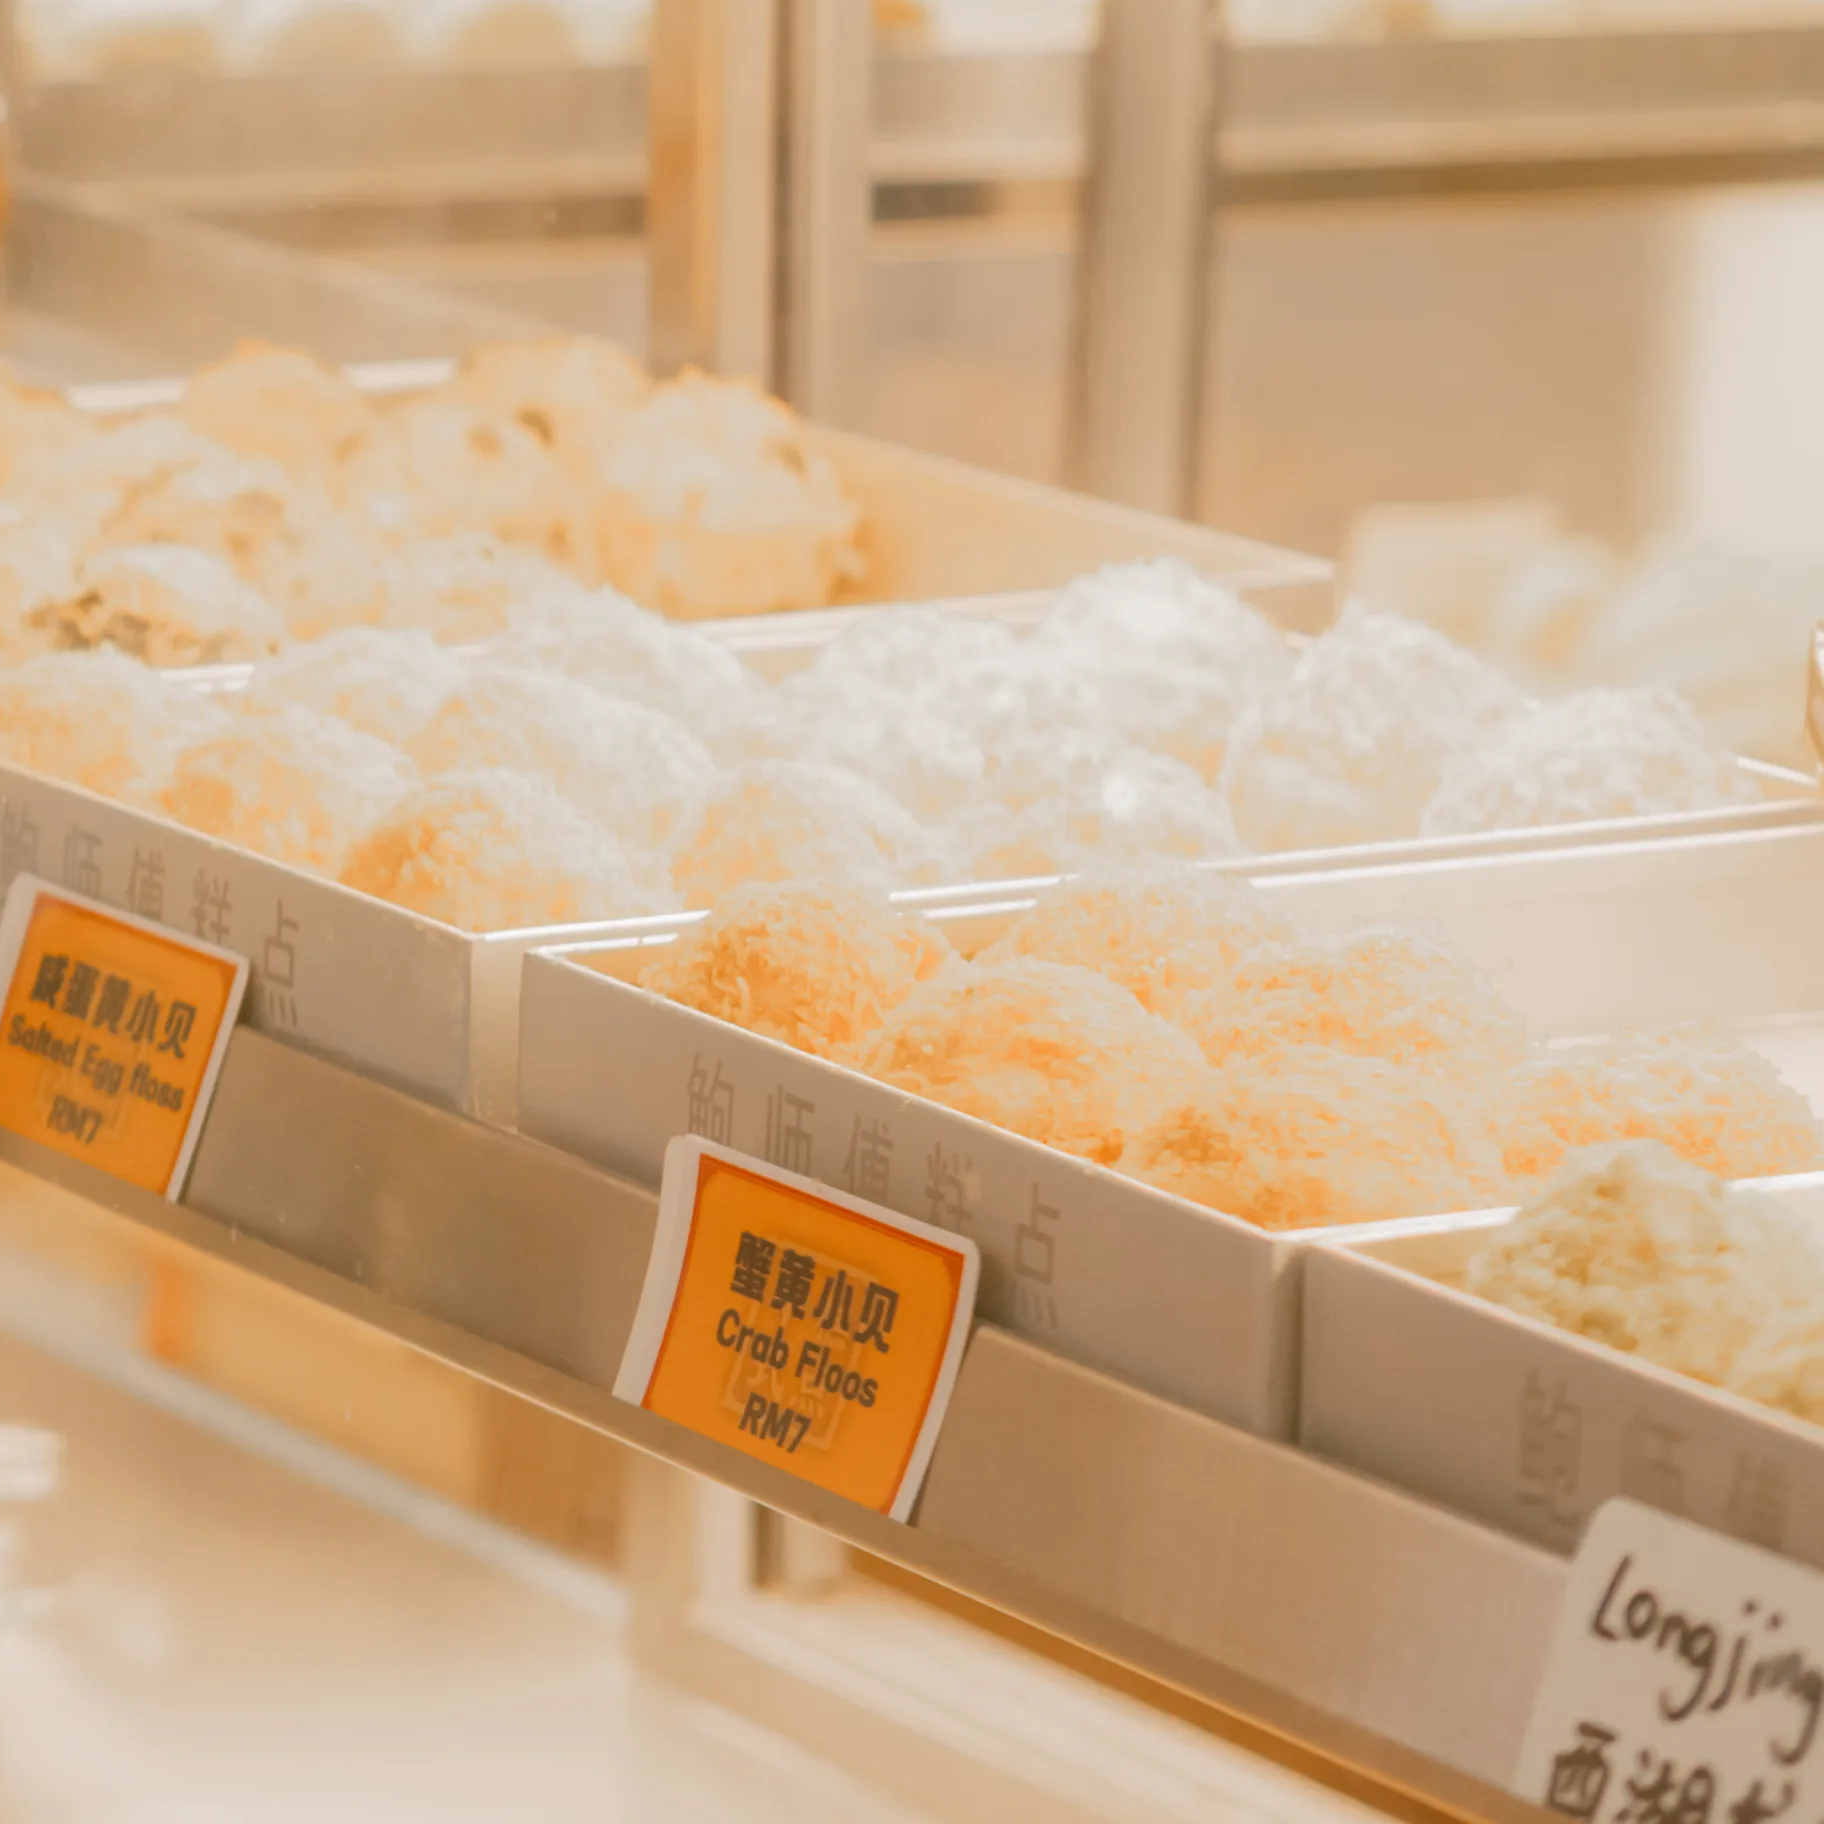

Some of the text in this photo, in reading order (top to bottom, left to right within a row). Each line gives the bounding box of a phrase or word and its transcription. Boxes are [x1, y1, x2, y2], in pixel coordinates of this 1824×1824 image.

[8, 1015, 78, 1068] Salted
[730, 1230, 900, 1353] 蟹黄小贝
[716, 1308, 880, 1409] Crab Floos
[738, 1393, 812, 1453] RM7
